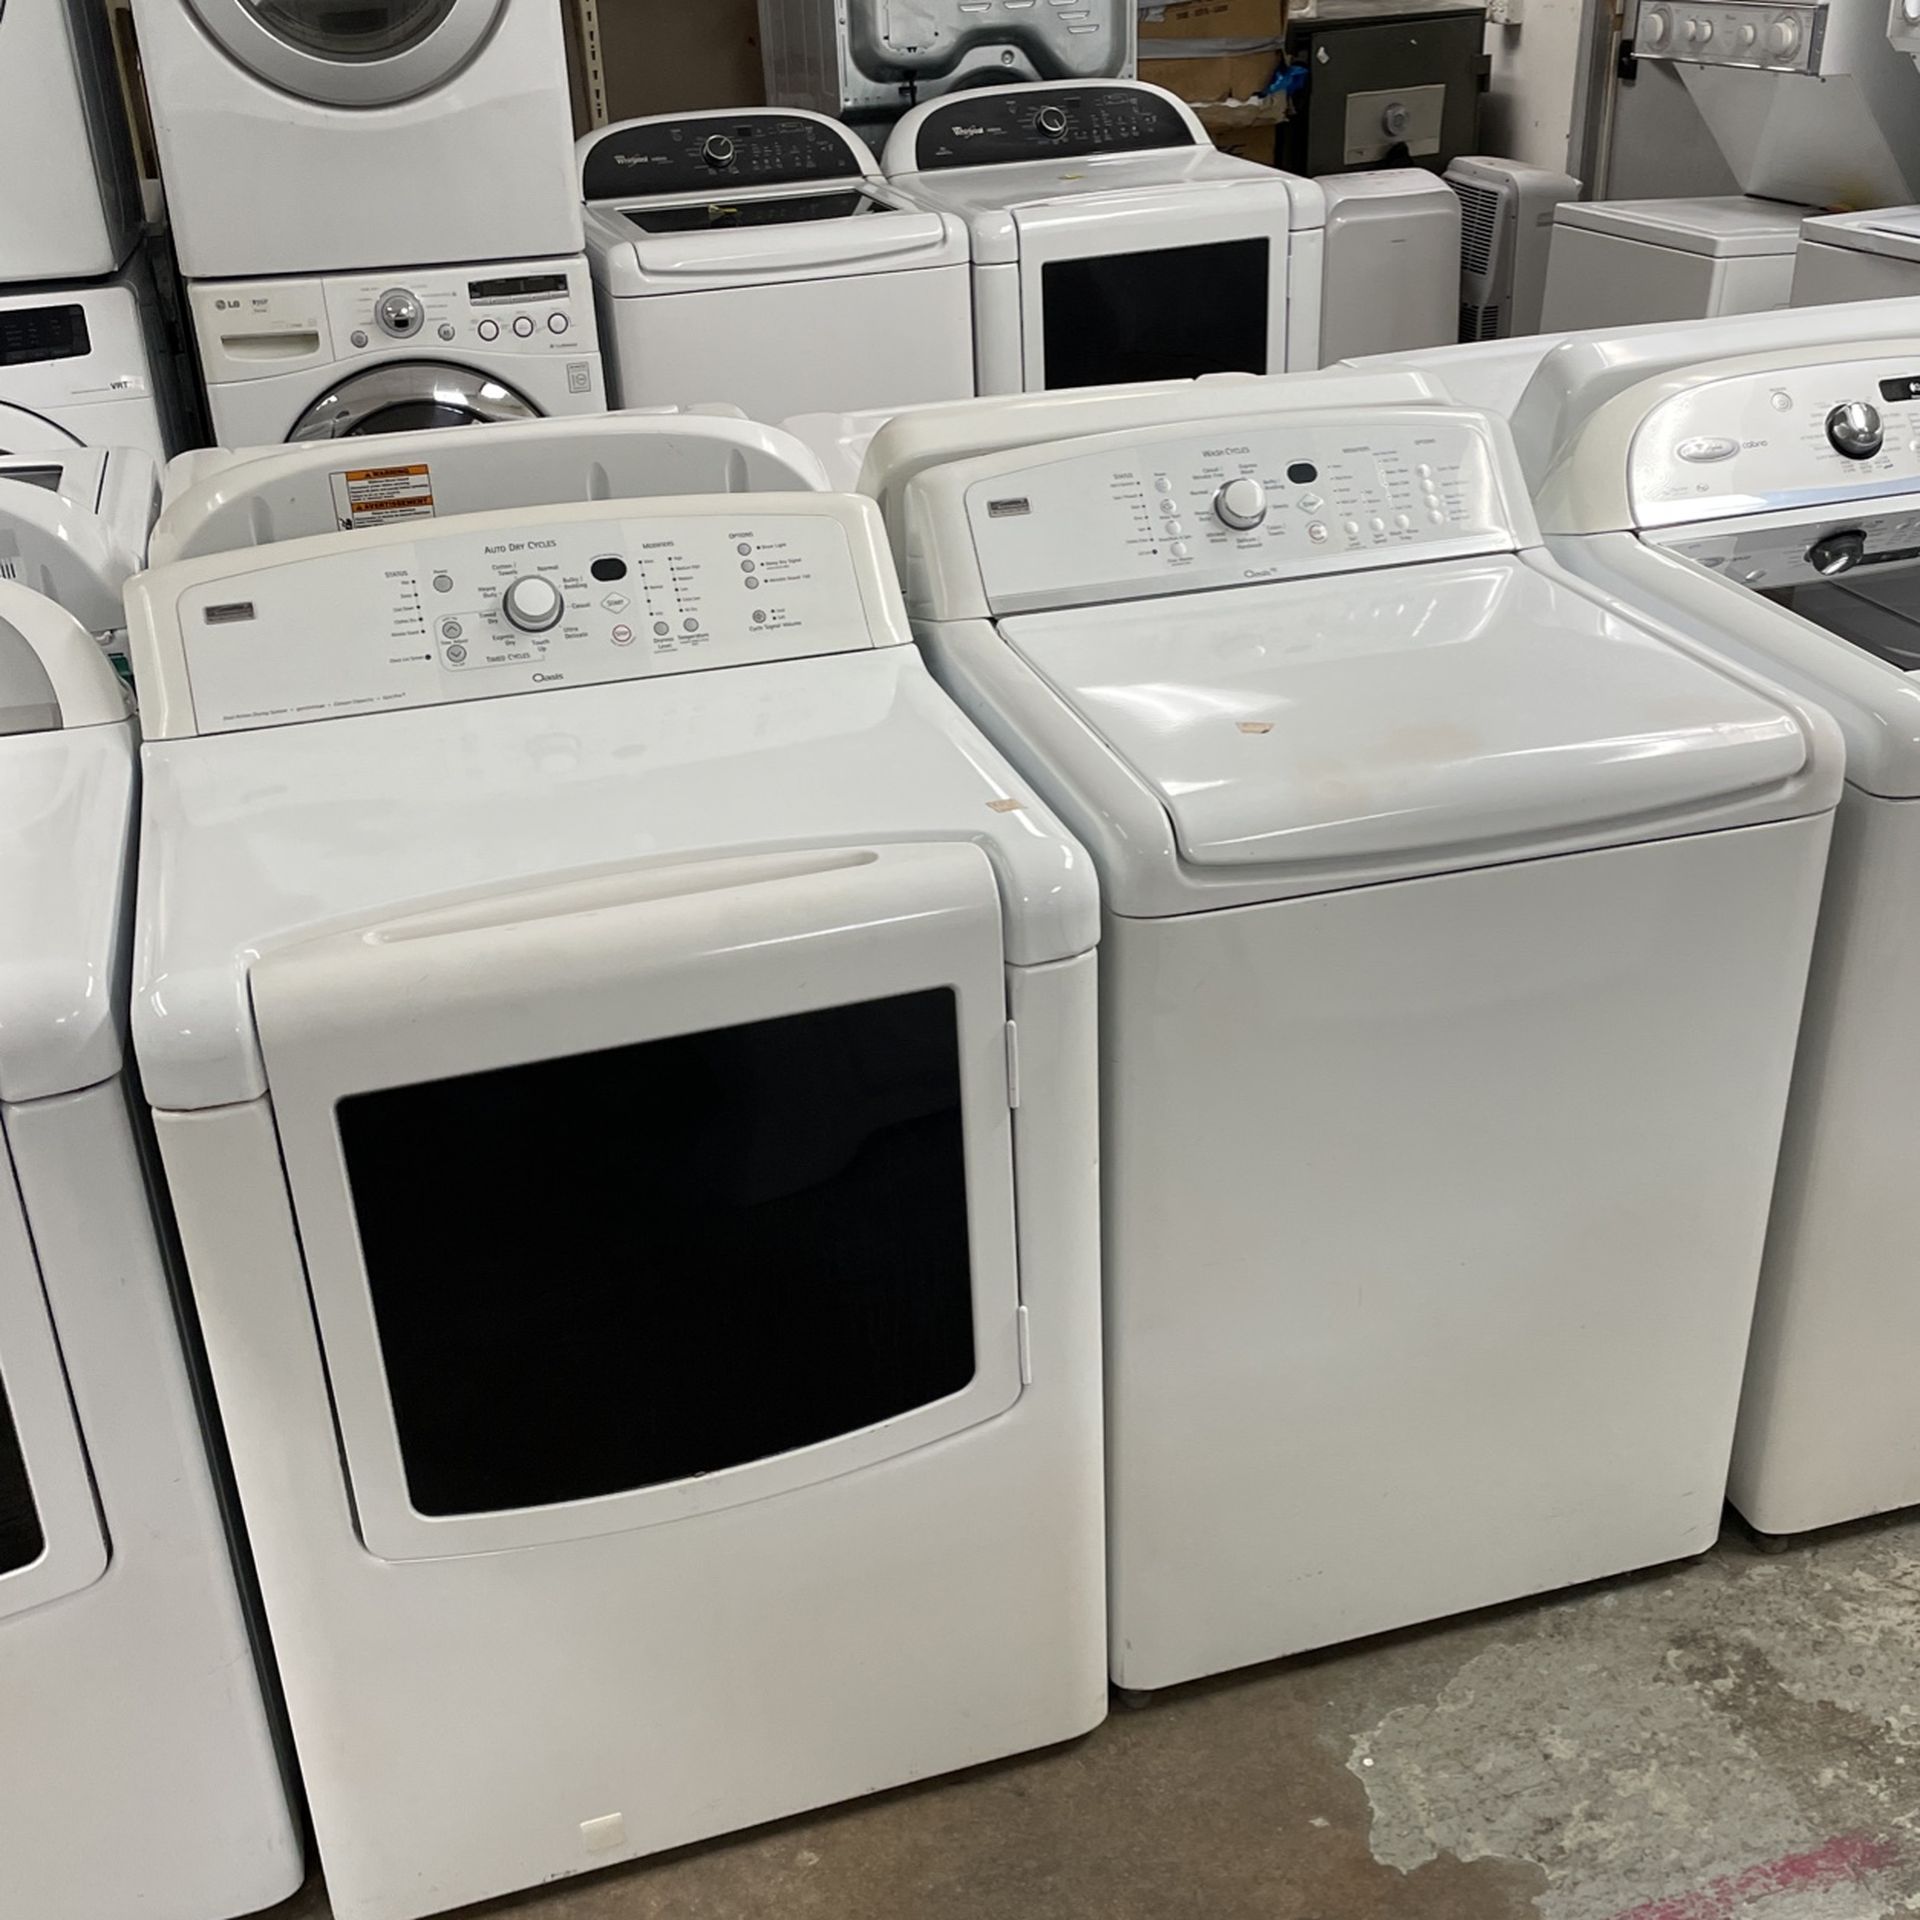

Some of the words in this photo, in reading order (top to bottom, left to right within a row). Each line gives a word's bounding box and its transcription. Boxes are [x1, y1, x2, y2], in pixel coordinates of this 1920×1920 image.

[227, 300, 240, 309] LG
[110, 381, 128, 390] VRT
[484, 546, 507, 555] AUTO
[508, 542, 525, 553] DRY
[527, 540, 557, 551] CYCLES
[537, 564, 559, 572] Normal
[532, 673, 564, 683] Oasis
